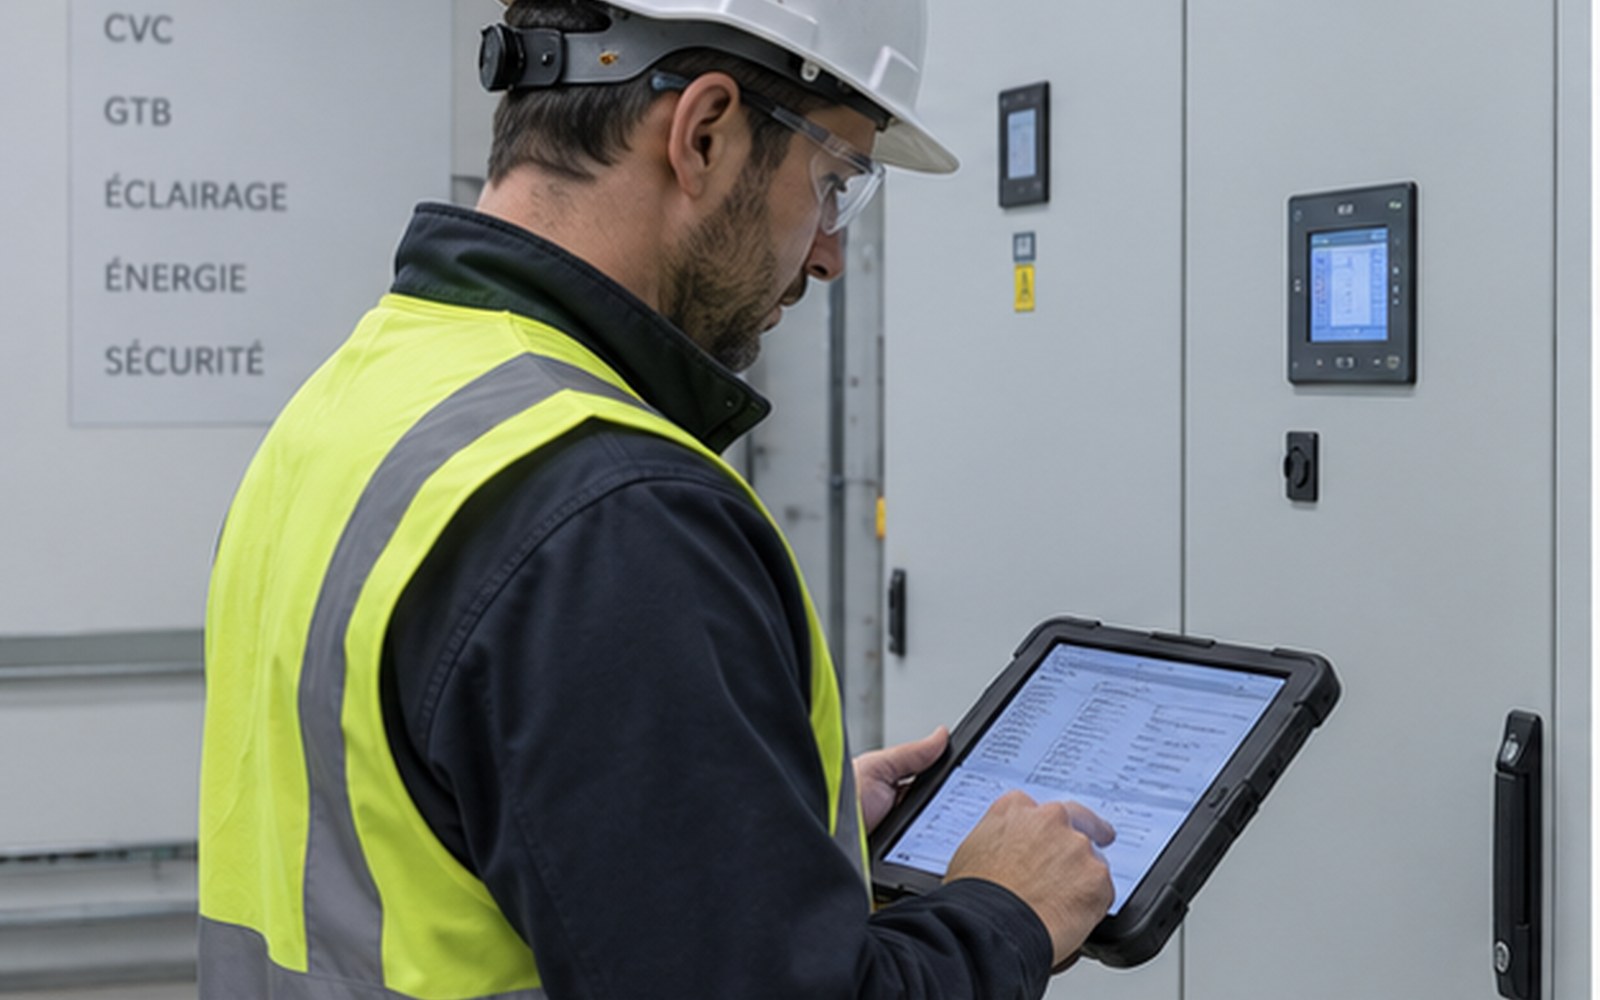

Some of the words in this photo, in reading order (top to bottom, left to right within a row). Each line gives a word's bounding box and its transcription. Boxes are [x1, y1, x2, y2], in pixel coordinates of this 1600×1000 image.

[104, 13, 173, 44] CVC
[104, 96, 172, 127] GTB
[104, 173, 287, 212] ÉCLAIRAGE
[104, 257, 246, 293] ÉNERGIE
[104, 339, 264, 376] SÉCURITÉ
